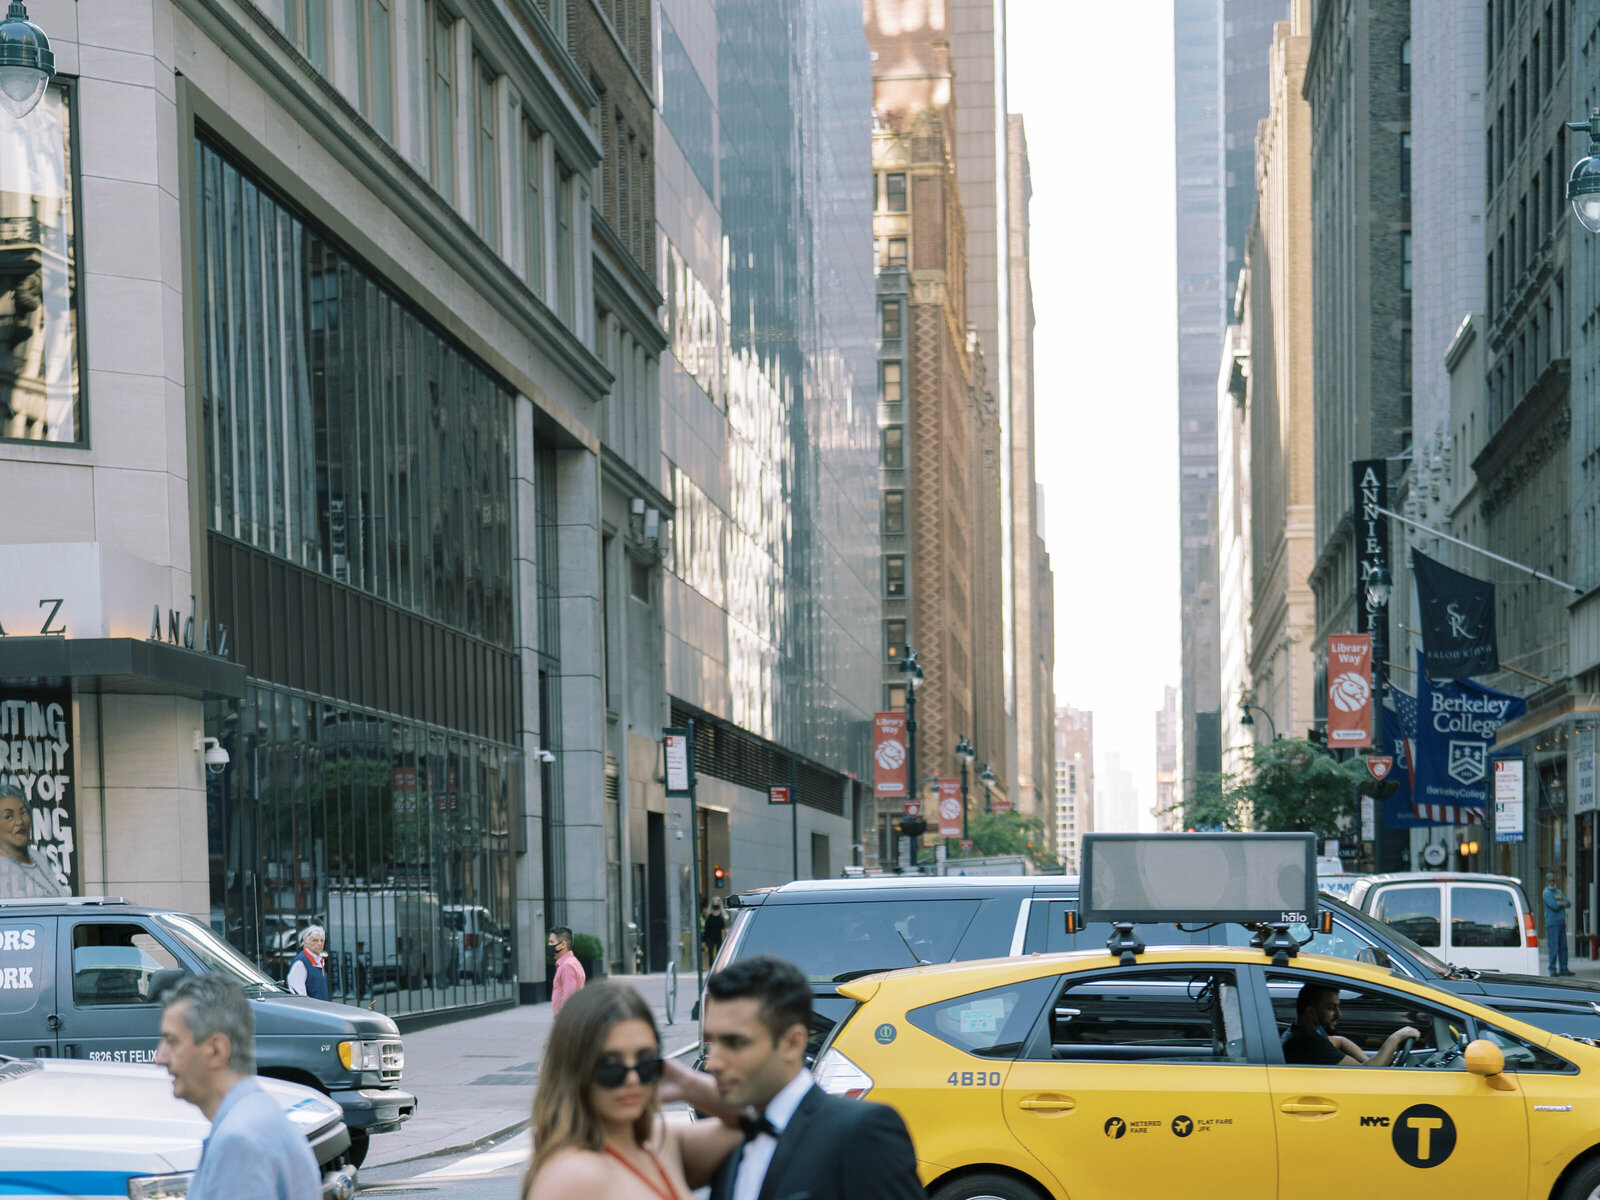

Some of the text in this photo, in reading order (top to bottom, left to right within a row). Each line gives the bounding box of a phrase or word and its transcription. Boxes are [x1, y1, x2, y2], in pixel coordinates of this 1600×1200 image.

[1360, 466, 1381, 554] ANNIE
[1331, 643, 1369, 655] Library
[1339, 654, 1361, 665] Way
[1431, 691, 1511, 719] Berkeley
[876, 717, 904, 727] Library
[1433, 712, 1502, 739] College
[881, 726, 899, 735] Way
[114, 1050, 127, 1062] ST
[129, 1049, 157, 1062] FELIX
[1360, 1116, 1390, 1127] NYC
[1406, 1117, 1443, 1160] T
